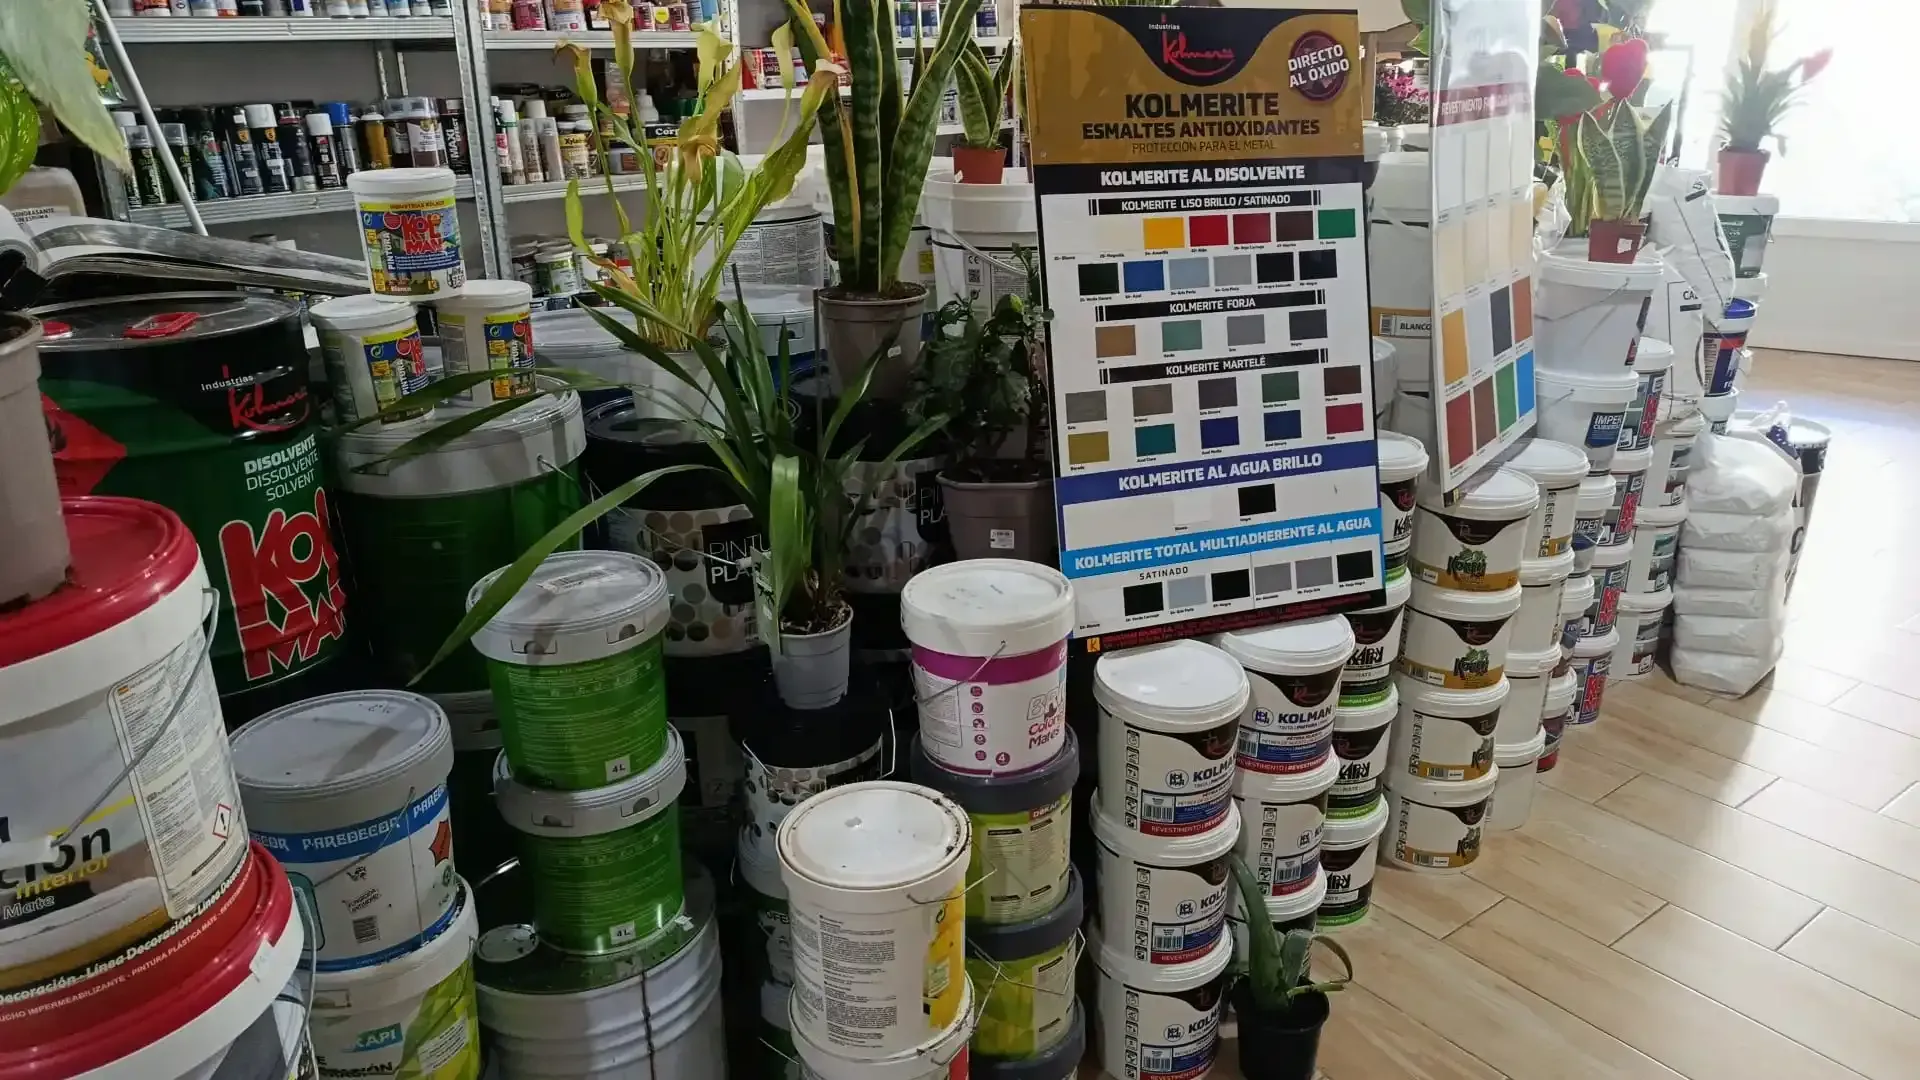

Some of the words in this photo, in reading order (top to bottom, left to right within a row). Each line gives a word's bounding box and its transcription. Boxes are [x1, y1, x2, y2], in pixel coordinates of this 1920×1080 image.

[1287, 44, 1344, 72] DIRECTO
[1289, 74, 1307, 88] AL
[1308, 58, 1350, 82] ÓXIDO
[1125, 92, 1280, 119] KOLMERITE
[1082, 121, 1176, 140] ESMALTES
[1179, 118, 1321, 138] ANTIOXIDANTES
[1132, 140, 1197, 154] PROTECCIÓN
[1199, 141, 1226, 153] PARA
[1227, 141, 1239, 151] EL
[1243, 140, 1277, 151] METAL
[1100, 170, 1189, 188] KOLMERITE
[1191, 170, 1213, 184] AL
[1215, 164, 1306, 183] DISOLVENTE
[1121, 199, 1178, 212] KOLMERITE
[1181, 198, 1203, 209] LISO
[1204, 196, 1237, 208] BRILLO
[1243, 194, 1292, 206] SATINADO
[1169, 299, 1224, 313] KOLMERITE
[1227, 298, 1257, 309] FORJA
[1400, 321, 1432, 331] BLANCO
[1165, 361, 1220, 375] KOLMERITE
[1222, 355, 1267, 370] MARTELÉ
[201, 373, 255, 391] Industrias
[243, 433, 317, 475] DISOLVENTE
[246, 448, 319, 491] DISSOLVENTE
[1118, 467, 1205, 491] KOLMERITE
[1207, 465, 1228, 480] AL
[1229, 459, 1271, 477] AGUA
[1272, 452, 1323, 472] BRILLO
[265, 468, 317, 502] SOLVENT
[1074, 549, 1153, 571] KOLMERITE
[1155, 542, 1198, 559] TOTAL
[1199, 526, 1316, 552] MULTIADHERENTE
[1317, 521, 1336, 536] AL
[1336, 515, 1373, 533] AGUA
[1139, 566, 1189, 581] SATINADO
[1278, 704, 1333, 724] KOLMAN
[254, 835, 290, 852] ECOR
[302, 816, 401, 851] PAREDECOR
[16, 856, 110, 900] interior
[2, 895, 56, 920] Mate
[27, 974, 126, 1016] IMPERMEABILIZANTE
[131, 952, 168, 977] PINTURA
[167, 929, 202, 956] PLÁSTICA
[201, 915, 218, 932] MATE
